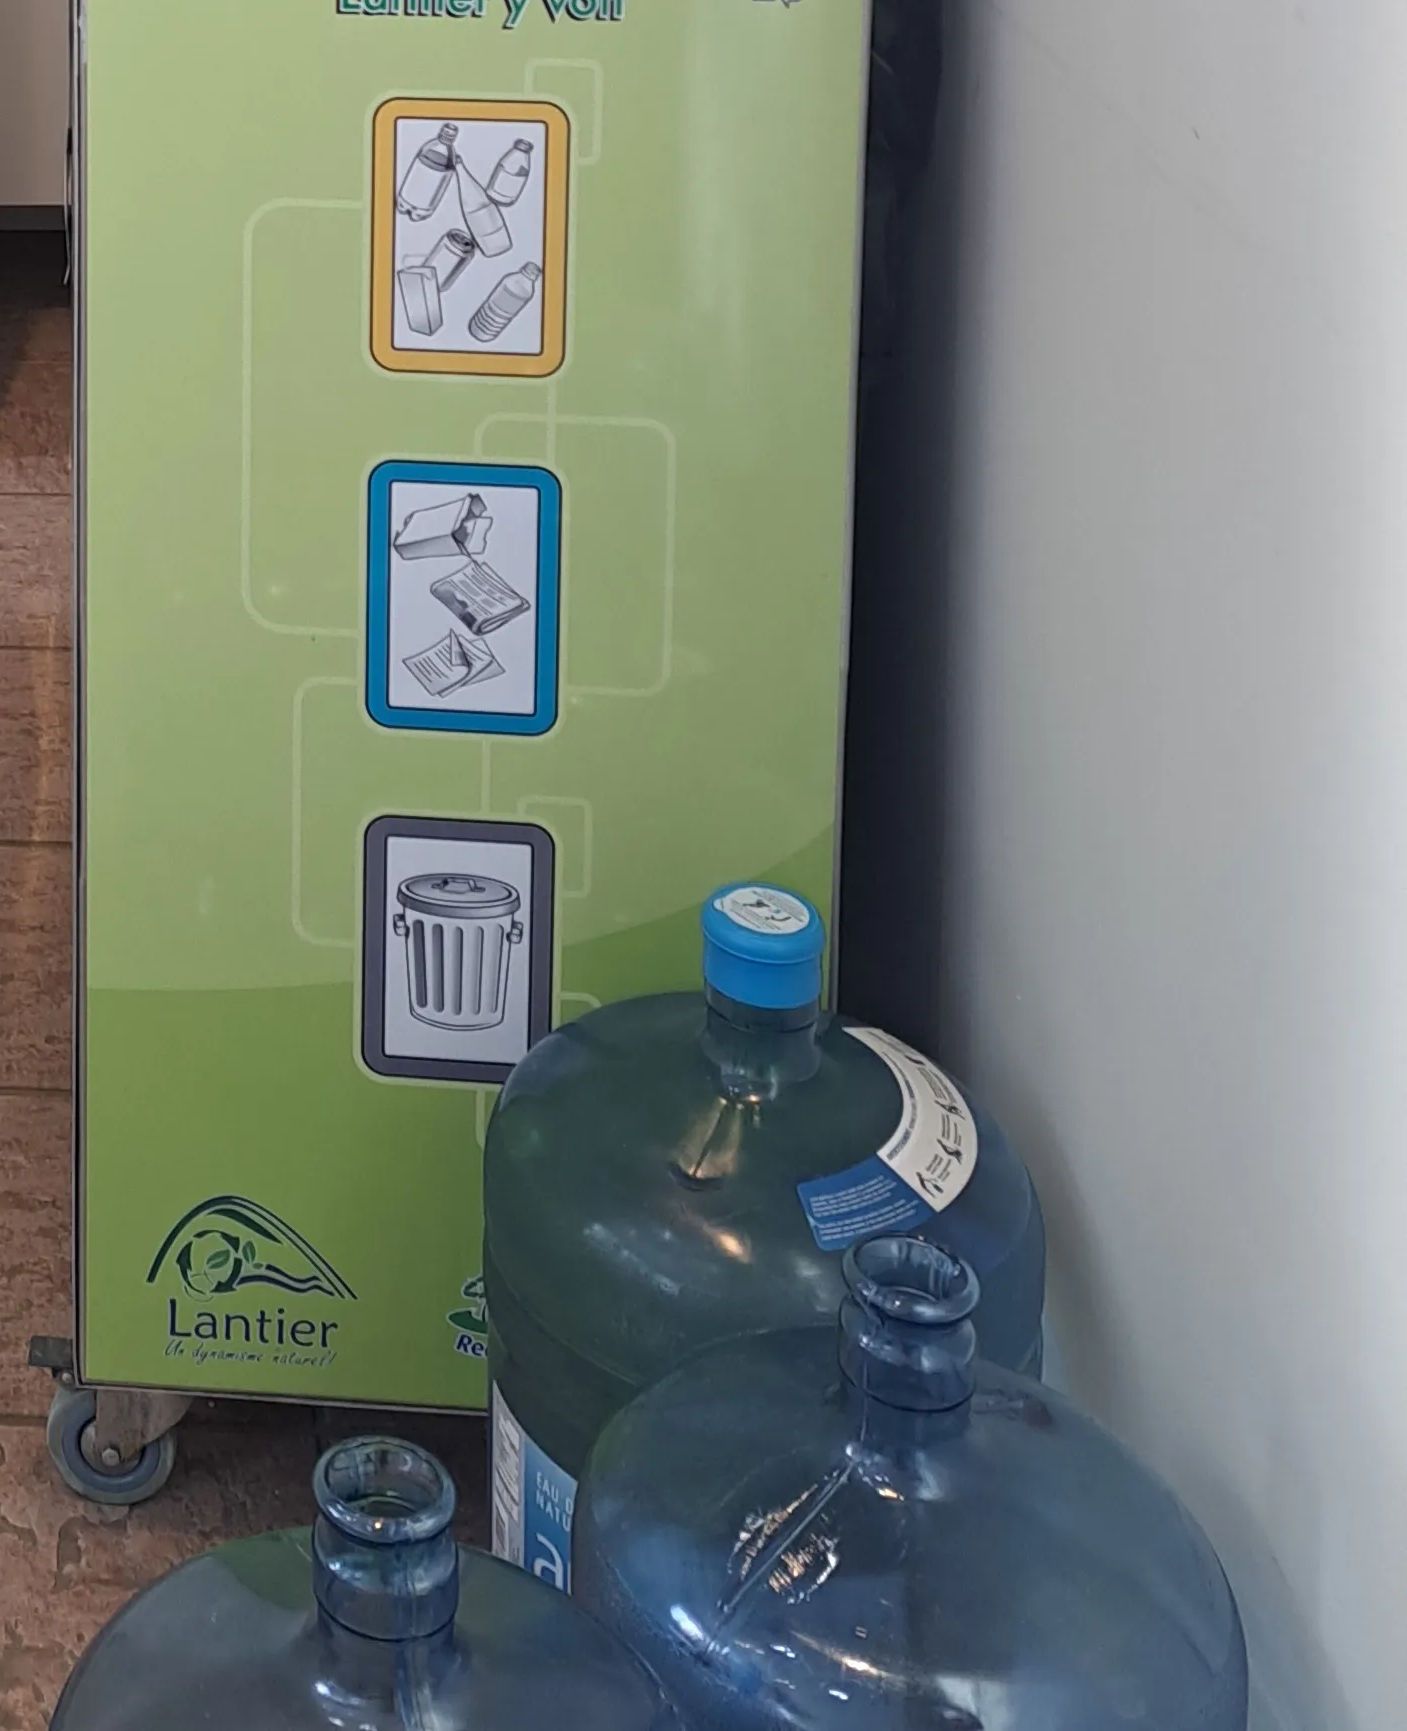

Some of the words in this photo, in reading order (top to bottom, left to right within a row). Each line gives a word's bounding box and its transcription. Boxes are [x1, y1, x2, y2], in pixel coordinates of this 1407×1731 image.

[169, 1298, 339, 1349] Lantier
[164, 1340, 184, 1357] Un
[192, 1342, 265, 1366] dynamisme
[535, 1489, 572, 1532] NATU
[536, 1471, 559, 1505] EAU
[565, 1496, 573, 1515] D
